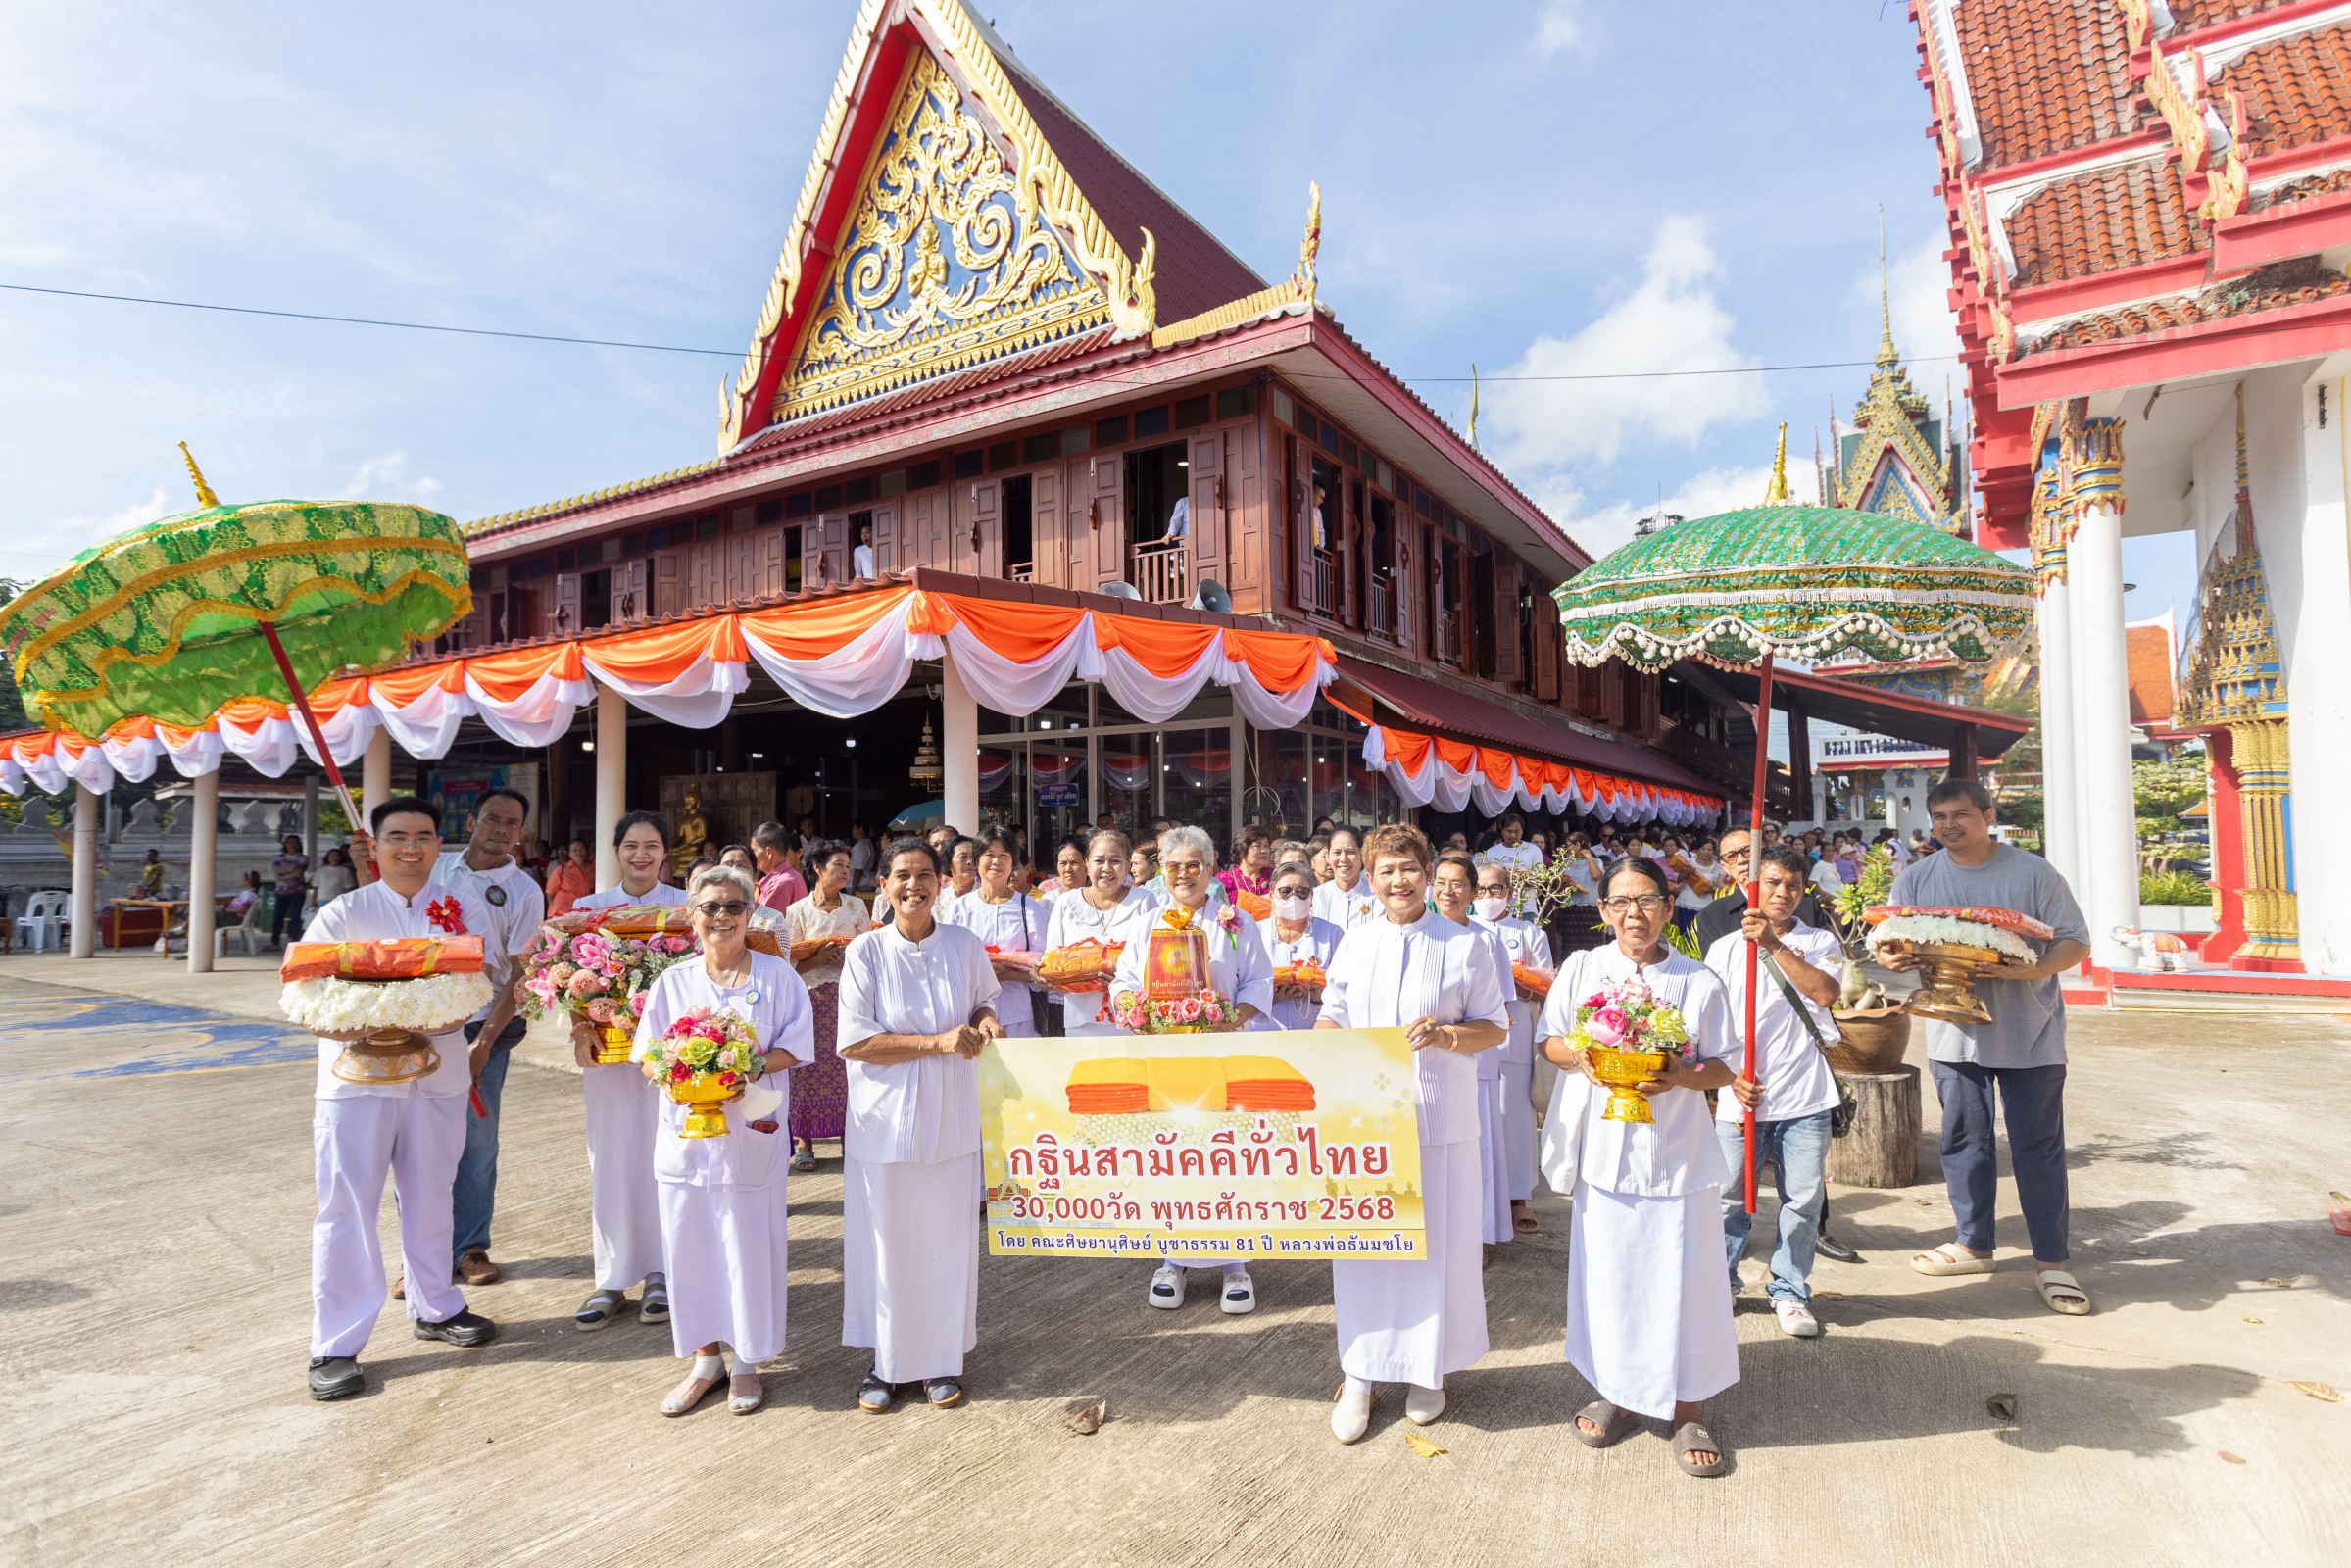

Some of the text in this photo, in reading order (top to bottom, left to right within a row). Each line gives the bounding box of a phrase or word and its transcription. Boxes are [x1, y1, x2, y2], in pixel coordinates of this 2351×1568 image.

[1010, 1119, 1388, 1190] กฐินสามัคคีทั่วไทย
[1012, 1191, 1394, 1230] 30,000วัด พุทธศักราช 2568
[998, 1231, 1413, 1254] โดย คณะศิษยานุศิษย์ บูชาธรรม 81 ปี หลวงพ่อธัมมชโย
